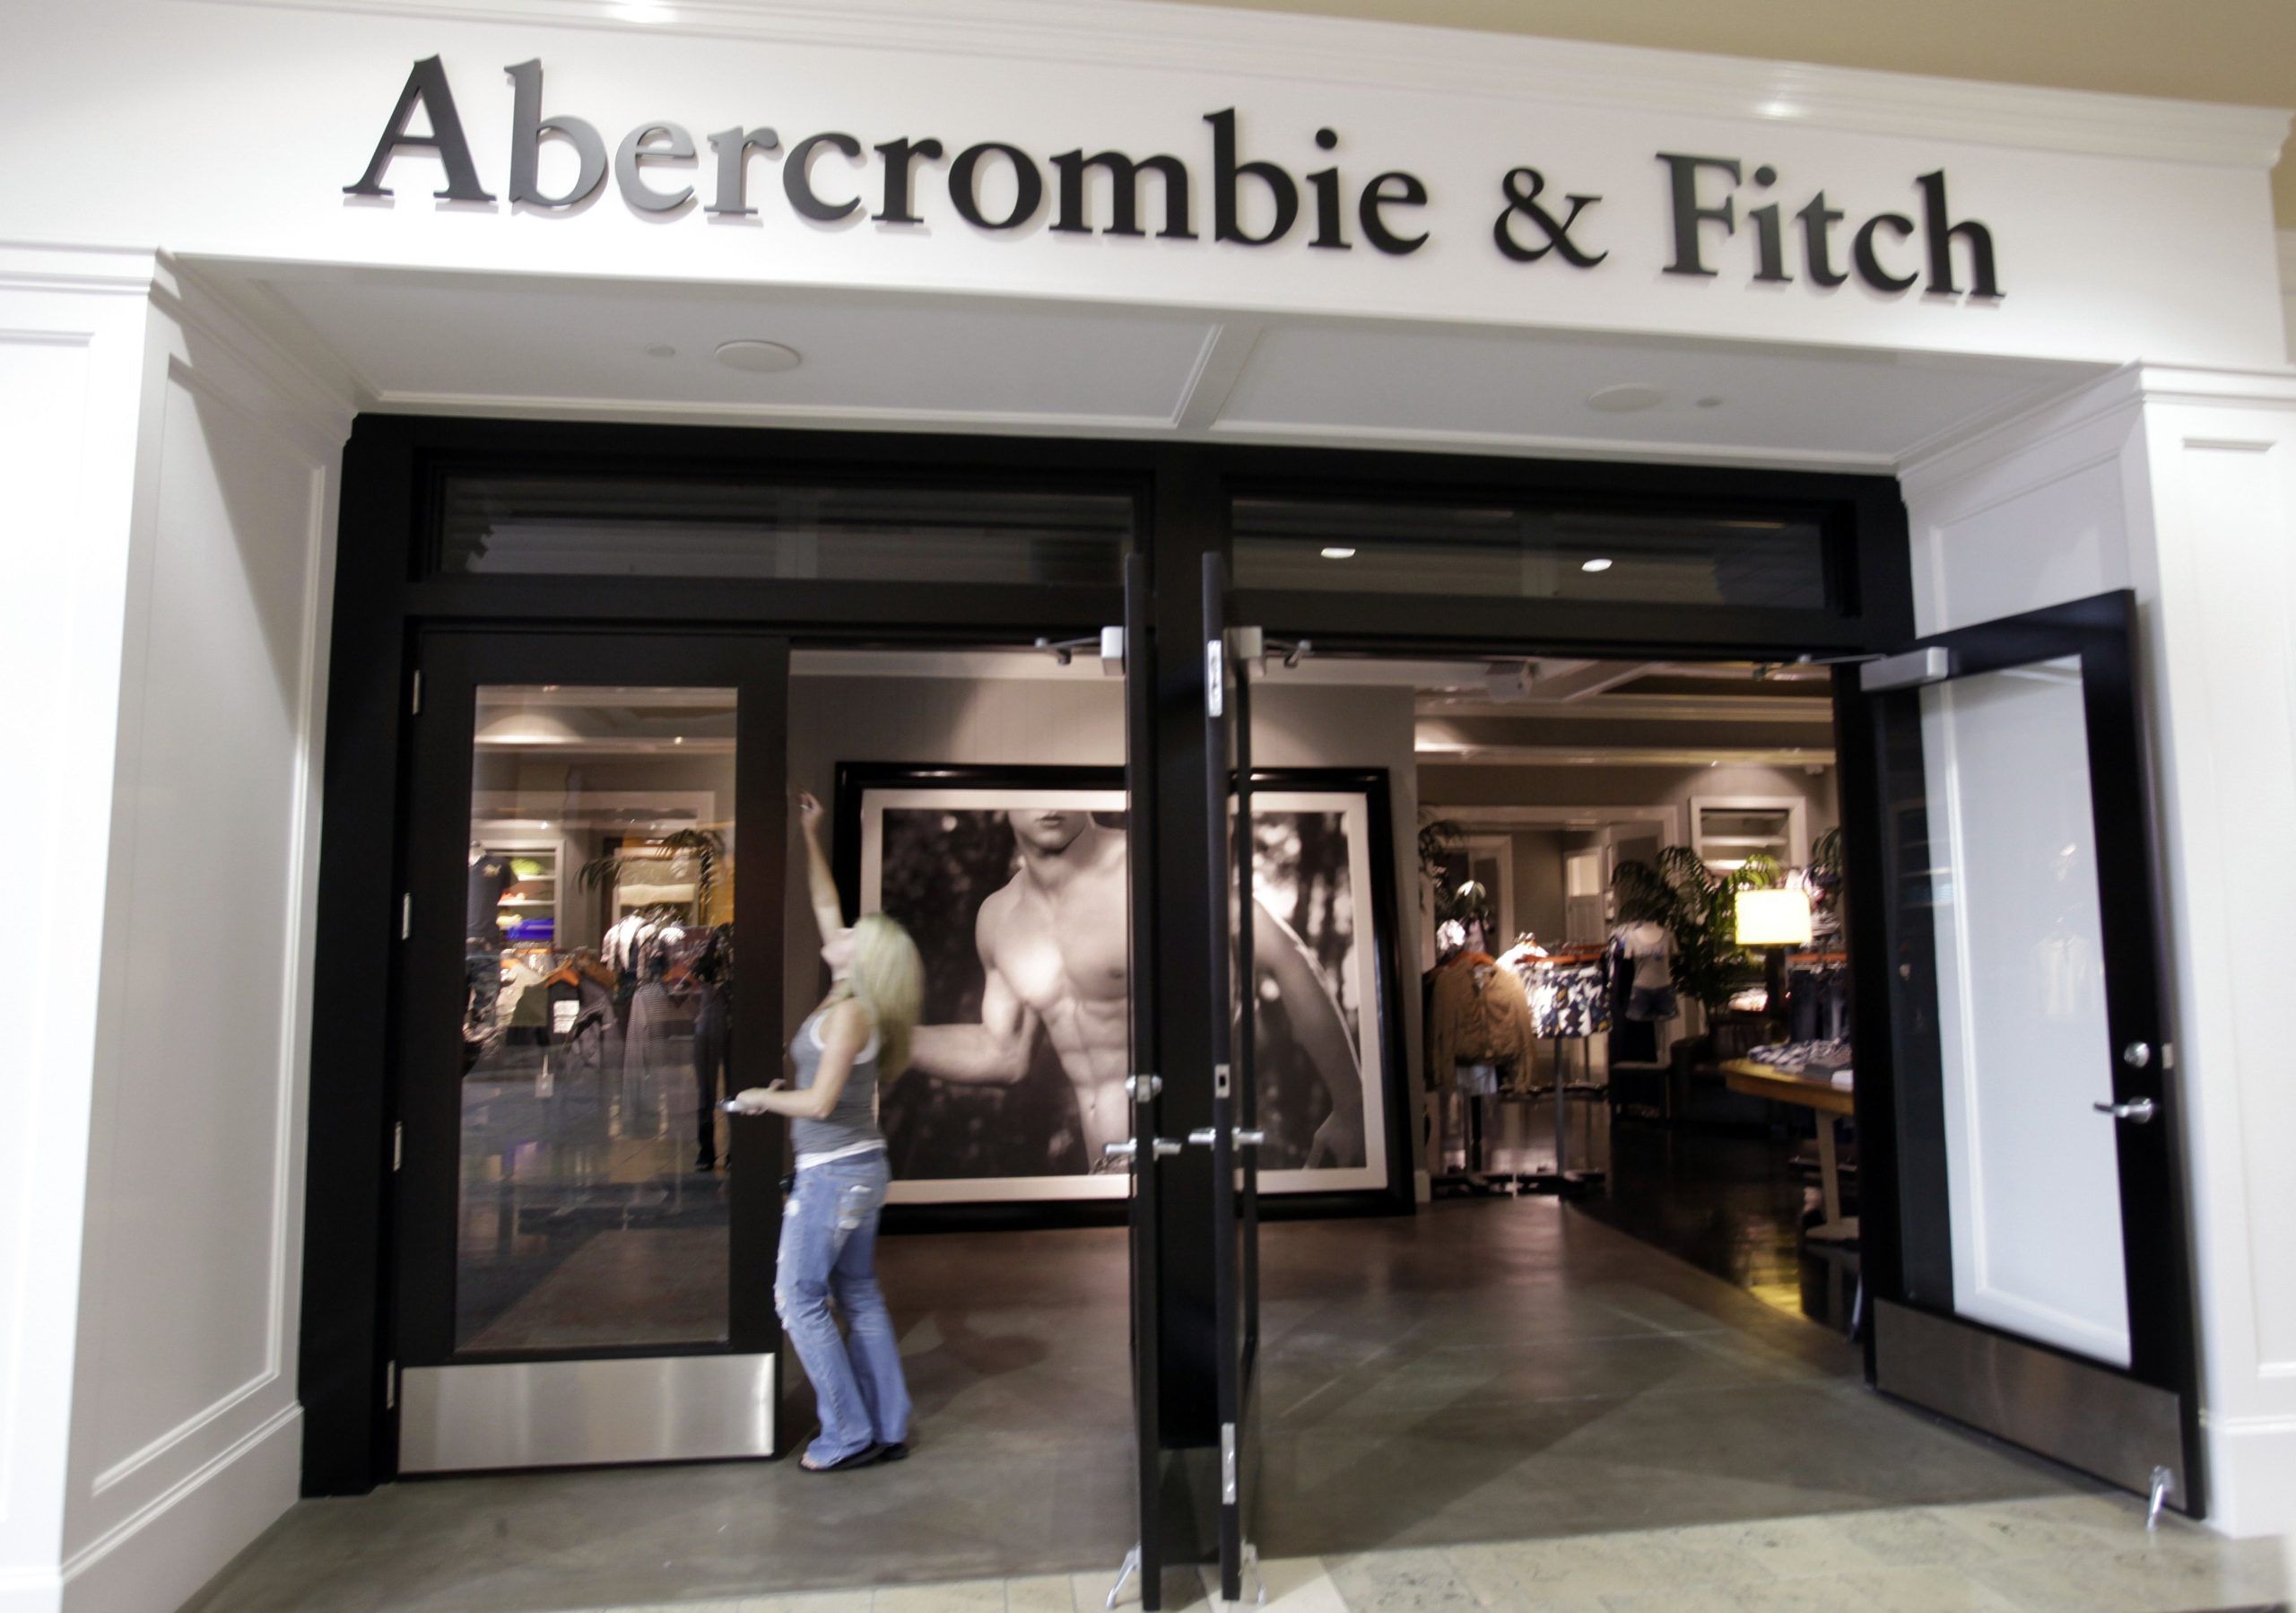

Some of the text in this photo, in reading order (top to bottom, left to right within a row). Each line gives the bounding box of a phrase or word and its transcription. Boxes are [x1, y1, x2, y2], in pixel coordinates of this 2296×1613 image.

[343, 54, 2005, 299] Abercrombie & Fitch
